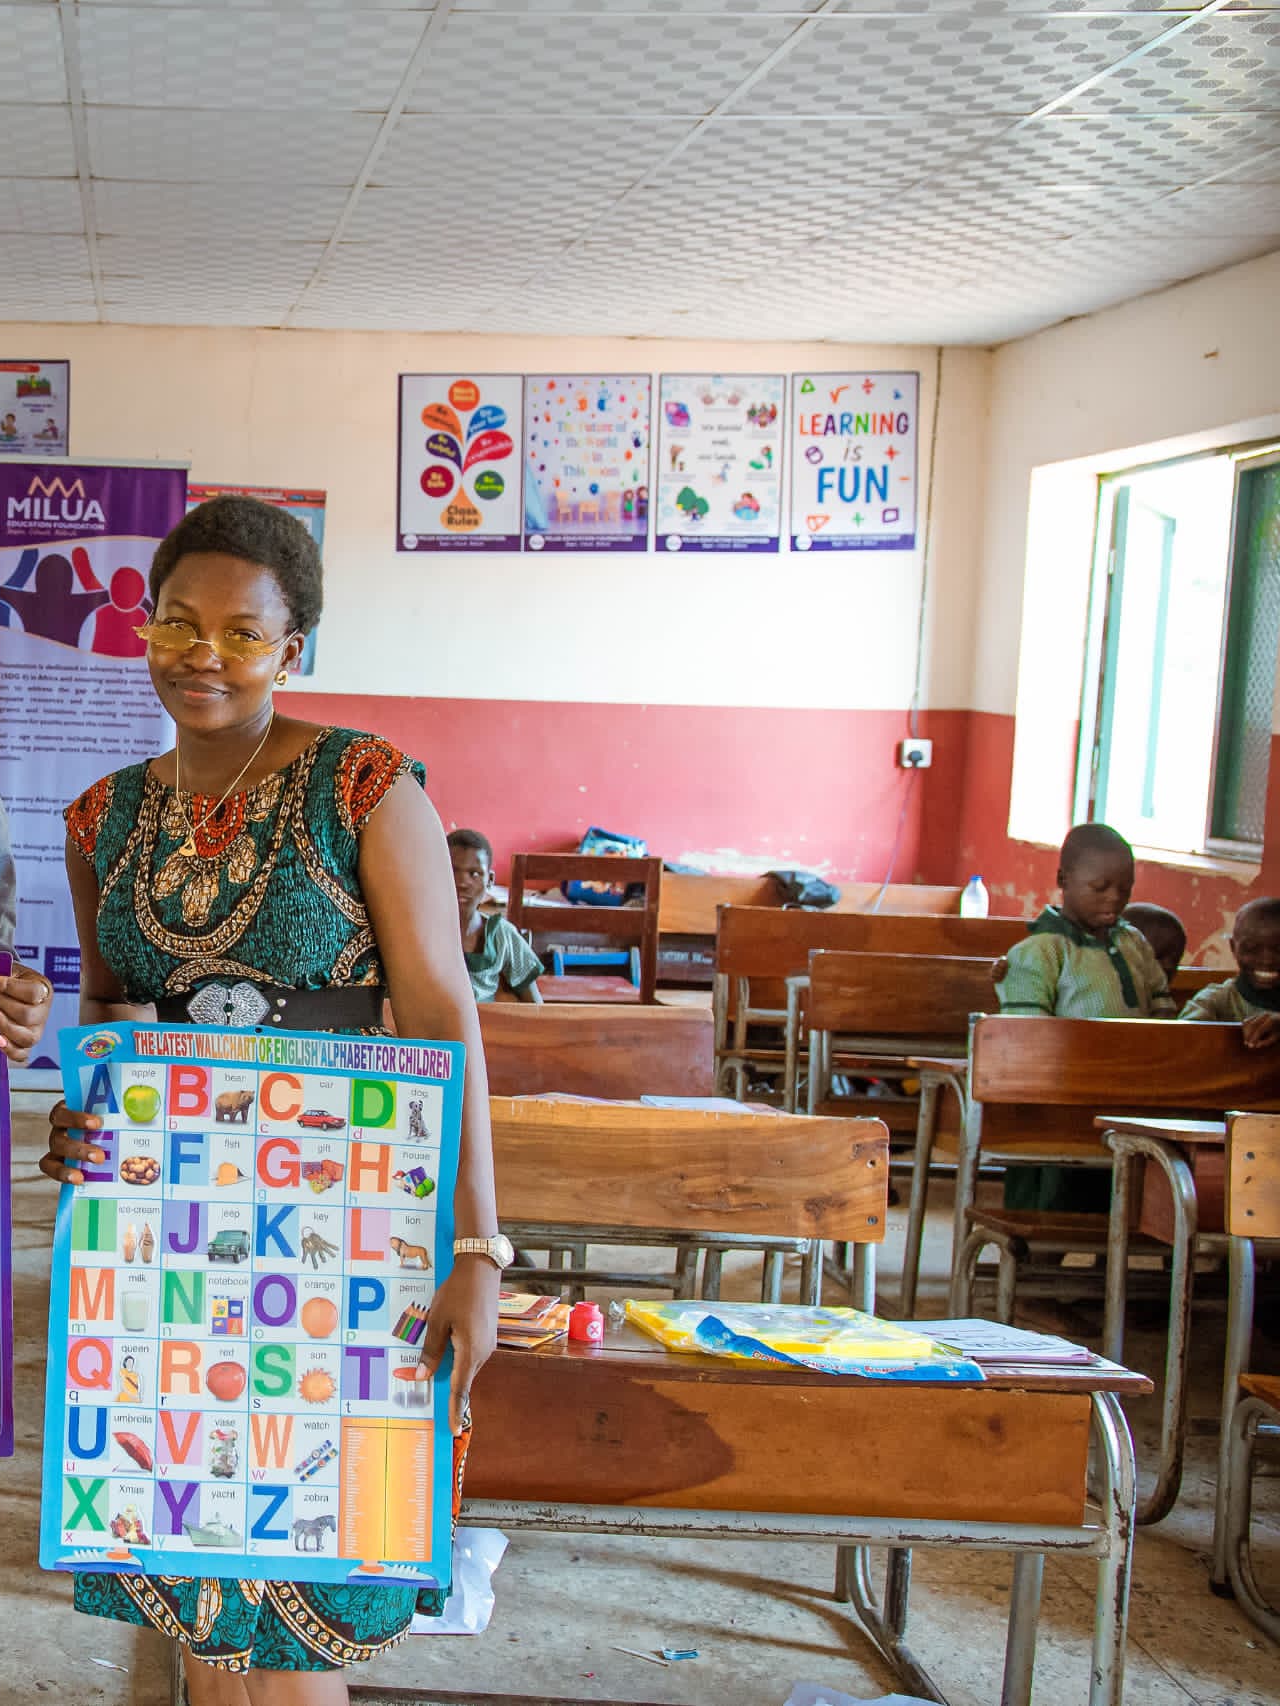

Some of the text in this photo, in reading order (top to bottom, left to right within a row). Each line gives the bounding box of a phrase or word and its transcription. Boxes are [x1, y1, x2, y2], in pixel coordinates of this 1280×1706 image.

[799, 412, 909, 436] LEARNING
[843, 439, 863, 462] is
[817, 465, 888, 503] FUN
[7, 497, 106, 522] MILUA
[447, 505, 478, 516] Class
[447, 516, 479, 526] Rules
[7, 521, 105, 531] EDUCATION FOUNDATION
[134, 1032, 154, 1056] THE
[156, 1033, 194, 1057] LATEST
[195, 1034, 257, 1062] WALLCHART
[258, 1037, 273, 1062] OF
[275, 1038, 318, 1065] ENGLISH
[320, 1040, 374, 1070] ALPHABET
[376, 1047, 397, 1072] FOR
[398, 1048, 451, 1079] CHILDREN
[131, 1068, 156, 1078] apple
[224, 1073, 246, 1082] bear
[84, 1063, 120, 1113] A
[169, 1064, 208, 1116] B
[260, 1072, 303, 1121] C
[410, 1087, 429, 1097] dog
[351, 1078, 393, 1128] D
[224, 1138, 240, 1149] fish
[353, 1128, 363, 1139] d
[82, 1131, 113, 1182] E
[170, 1133, 204, 1184] F
[317, 1143, 331, 1154] gift
[256, 1138, 301, 1188] G
[349, 1142, 390, 1192] H
[88, 1200, 99, 1251] I
[168, 1202, 200, 1254] J
[313, 1211, 329, 1222] key
[405, 1215, 421, 1225] lion
[256, 1205, 297, 1258] K
[350, 1208, 384, 1260] L
[128, 1273, 146, 1282] milk
[304, 1280, 335, 1290] orange
[399, 1283, 426, 1294] pencil
[70, 1268, 115, 1320] M
[163, 1271, 203, 1324] N
[253, 1274, 297, 1327] O
[348, 1277, 386, 1329] P
[121, 1344, 150, 1354] queen
[220, 1348, 234, 1357] red
[310, 1352, 327, 1360] sun
[68, 1337, 112, 1390] Q
[160, 1341, 202, 1394] R
[254, 1345, 292, 1397] S
[345, 1347, 385, 1400] T
[69, 1390, 79, 1403] q
[161, 1395, 167, 1405] r
[253, 1399, 261, 1408] s
[346, 1402, 351, 1413] t
[114, 1414, 152, 1424] umbrella
[303, 1421, 330, 1430] watch
[68, 1406, 107, 1460] U
[159, 1410, 201, 1464] V
[250, 1413, 294, 1468] W
[119, 1485, 145, 1494] Xmas
[211, 1489, 236, 1499] yacht
[303, 1493, 329, 1503] zebra
[64, 1477, 106, 1531] X
[157, 1481, 200, 1535] Y
[250, 1485, 289, 1540] Z
